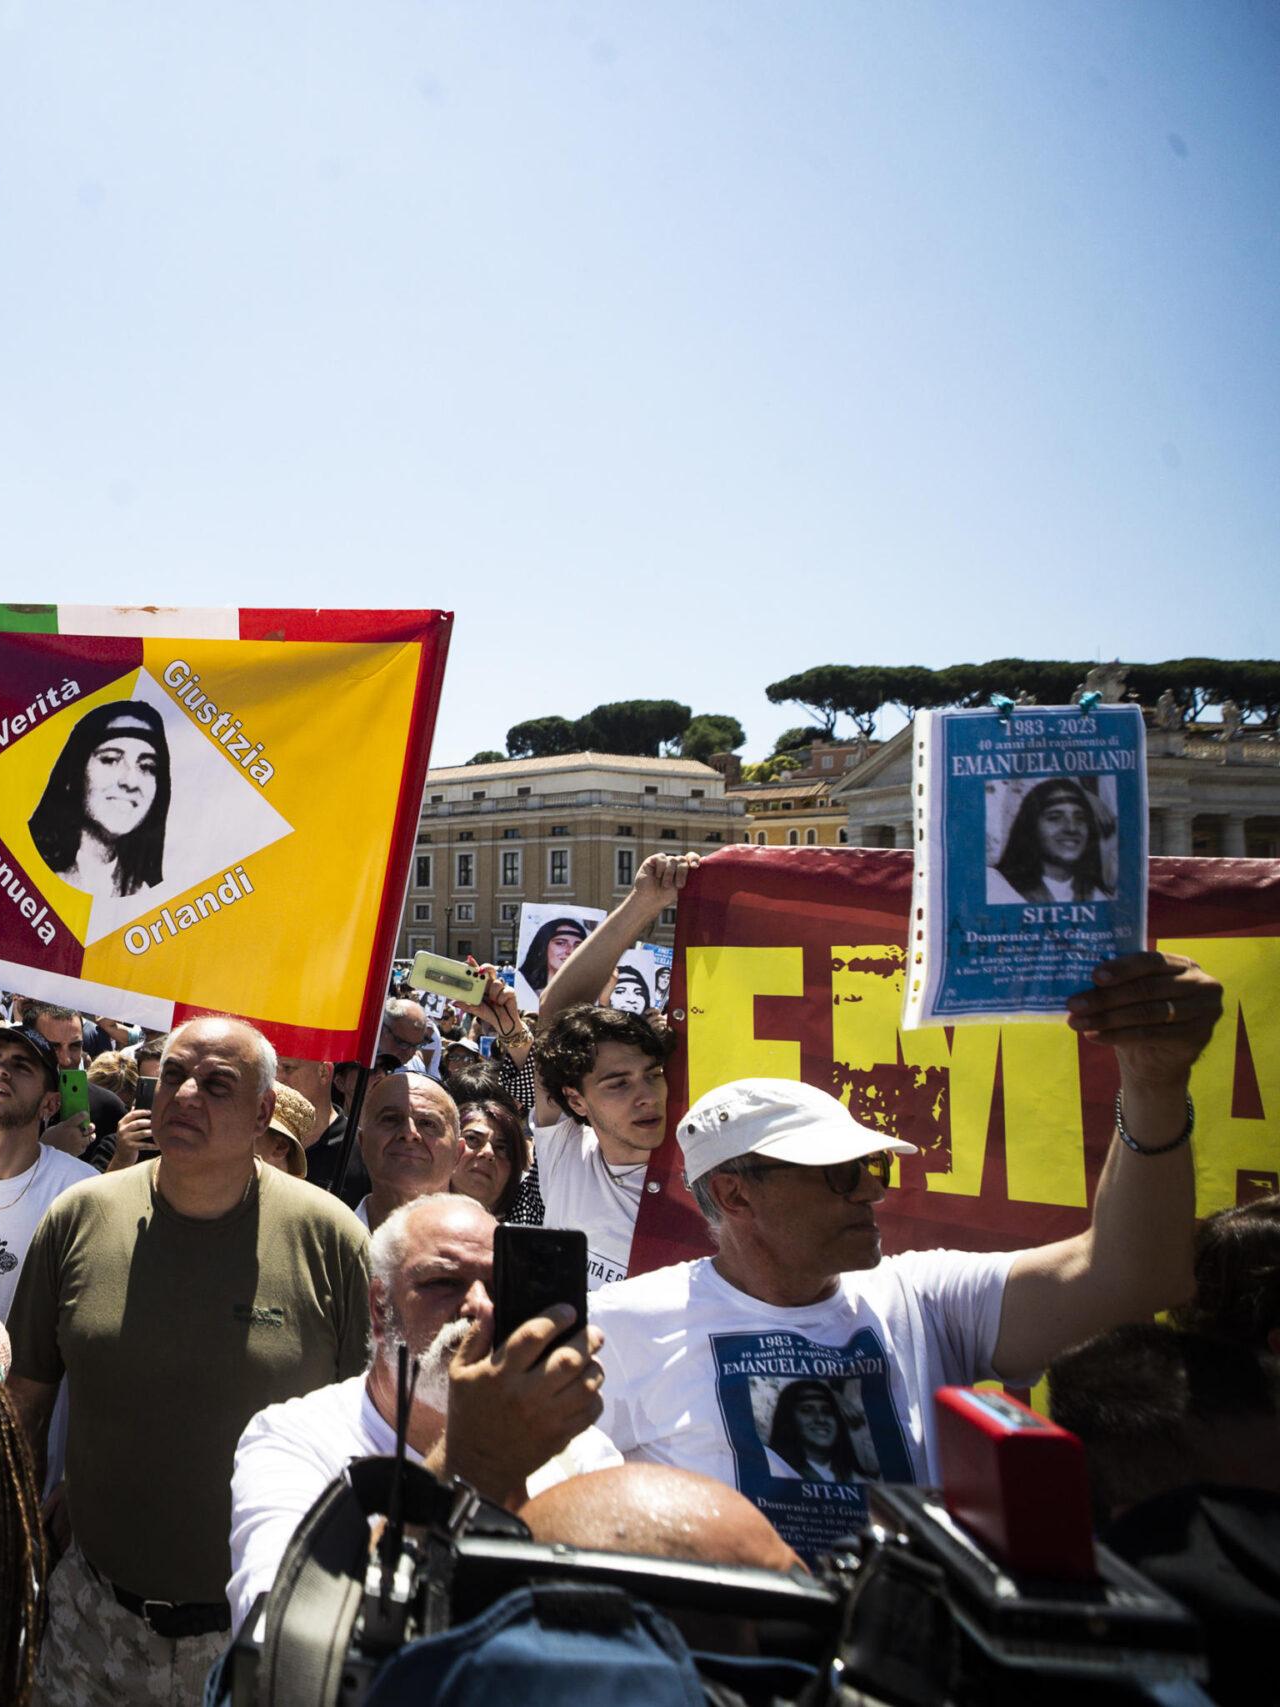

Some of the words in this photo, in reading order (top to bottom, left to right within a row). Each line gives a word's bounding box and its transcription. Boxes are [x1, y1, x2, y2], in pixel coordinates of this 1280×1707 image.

[162, 659, 277, 787] Giustizia
[1003, 719, 1045, 737] 1983
[1059, 718, 1098, 735] 2023
[977, 740, 993, 751] 40
[995, 738, 1026, 750] anni
[1027, 737, 1047, 749] dal
[1048, 736, 1107, 750] rapimento
[1108, 735, 1120, 746] di
[952, 752, 1062, 776] EMANUELA
[1063, 750, 1137, 772] ORLANDI
[121, 864, 256, 957] Orlandi
[1023, 905, 1097, 924] SIT-IN
[966, 929, 1040, 943] Domenica
[1044, 928, 1061, 941] 25
[1063, 928, 1113, 941] Giugno
[758, 1336, 792, 1349] 1983
[754, 1349, 776, 1359] anni
[778, 1347, 796, 1357] dal
[722, 1357, 811, 1375] EMANUELA
[813, 1357, 884, 1377] ORLANDI
[801, 1483, 861, 1501] SIT-IN
[757, 1496, 819, 1513] Domenica
